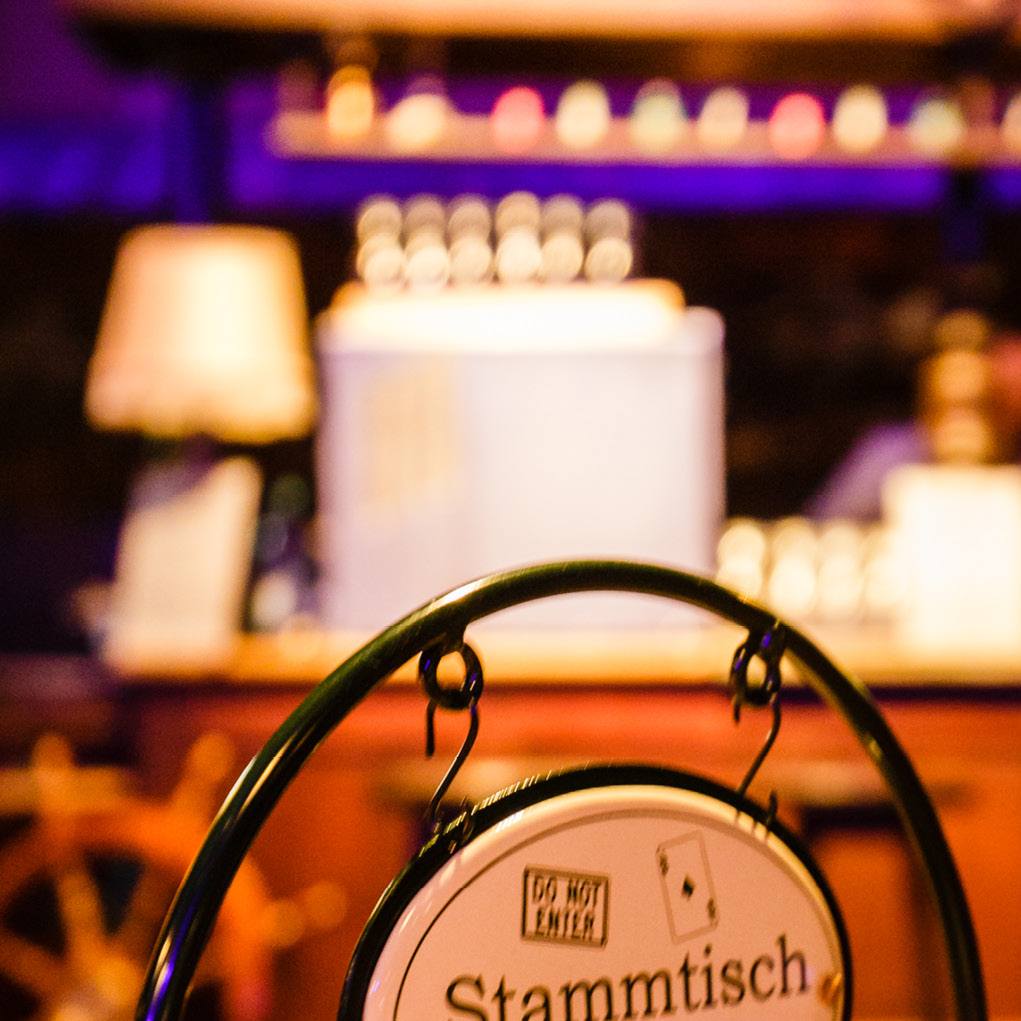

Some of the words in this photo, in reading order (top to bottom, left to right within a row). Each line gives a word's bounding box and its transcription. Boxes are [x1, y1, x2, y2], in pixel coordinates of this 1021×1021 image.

[532, 875, 558, 904] DO
[567, 878, 602, 908] NOT
[535, 907, 595, 941] ENTER
